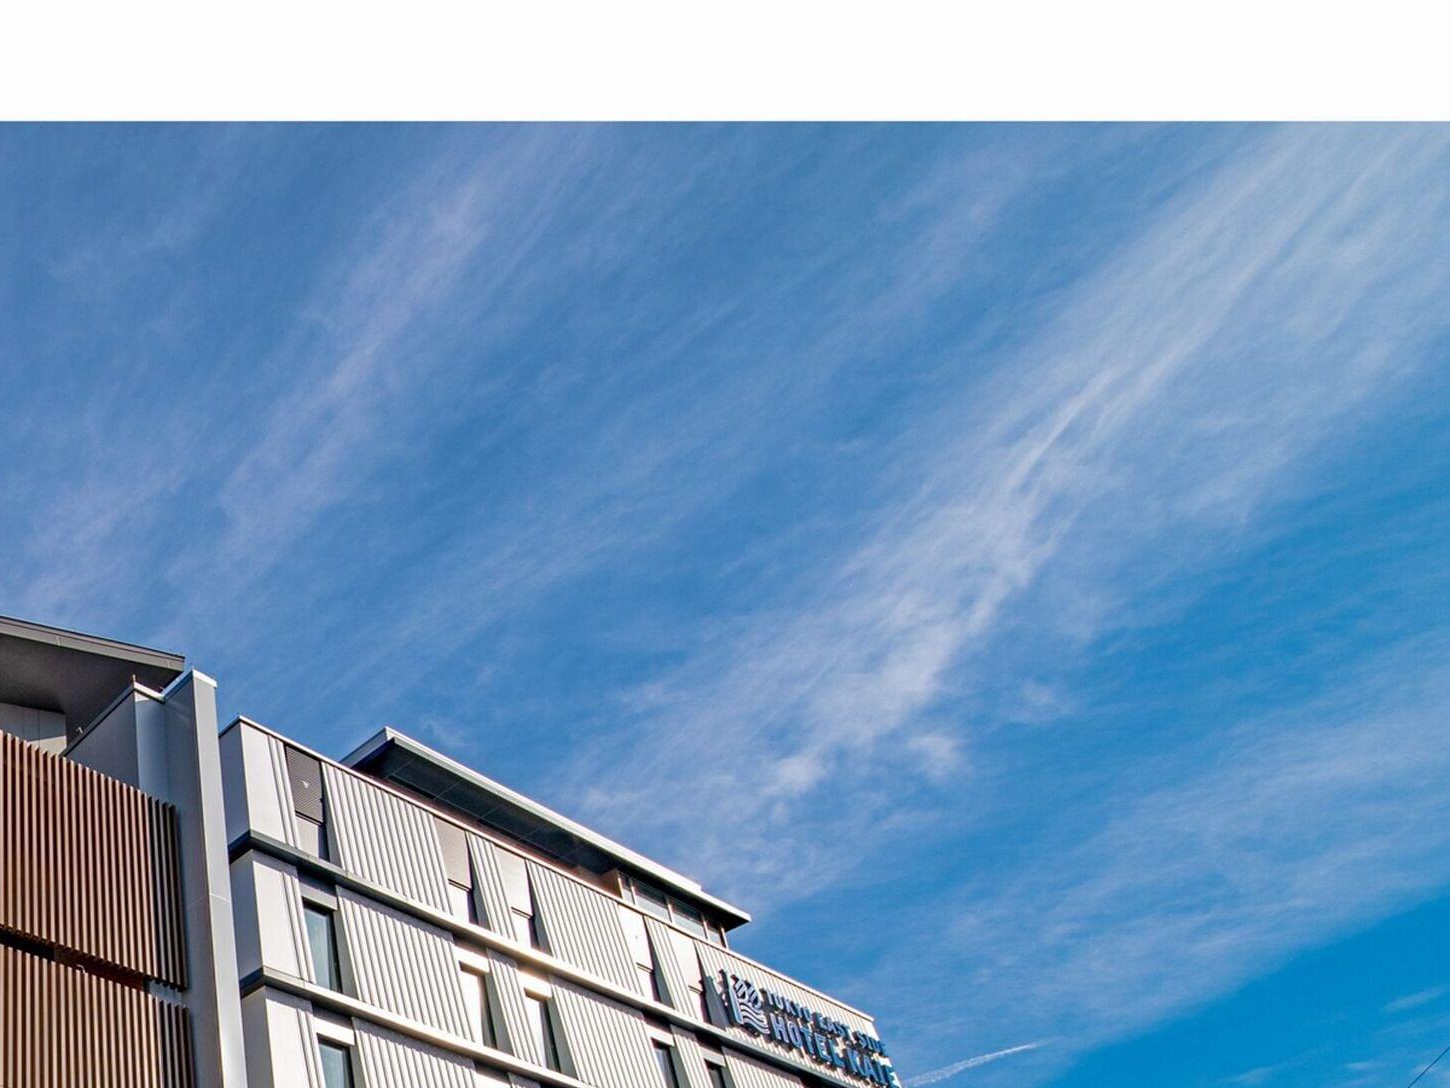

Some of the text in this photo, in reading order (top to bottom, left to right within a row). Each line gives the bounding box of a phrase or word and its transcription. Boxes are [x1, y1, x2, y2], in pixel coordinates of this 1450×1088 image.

[767, 989, 812, 1021] TOKYO
[818, 1013, 851, 1041] EAST
[770, 1013, 845, 1068] HOTEL
